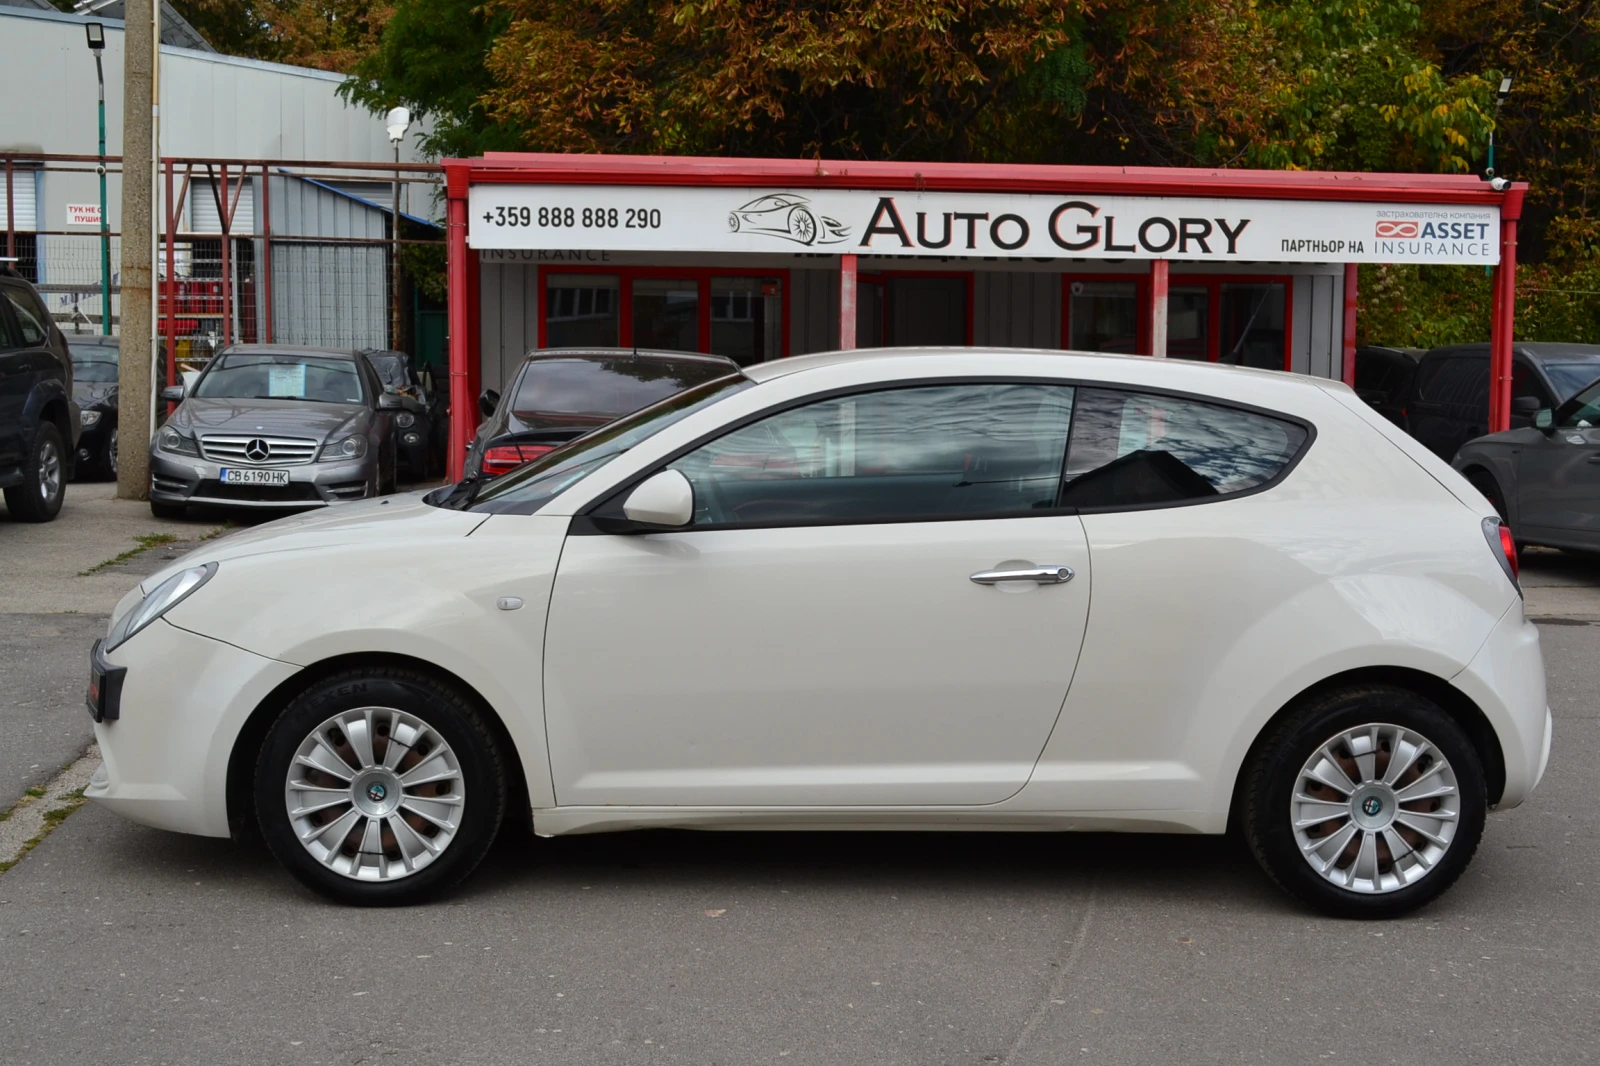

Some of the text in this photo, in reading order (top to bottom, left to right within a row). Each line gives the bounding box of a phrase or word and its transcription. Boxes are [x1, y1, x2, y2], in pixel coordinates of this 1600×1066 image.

[85, 206, 96, 214] НЕ
[1376, 210, 1491, 220] застрахователна компания
[482, 206, 662, 229] +359 888 888 290
[1420, 222, 1490, 240] ASSET
[1281, 239, 1365, 254] ПАРТНЬОР НА
[1374, 241, 1490, 256] INSURANCE
[481, 248, 611, 262] INSURANCE
[243, 471, 271, 483] 6190
